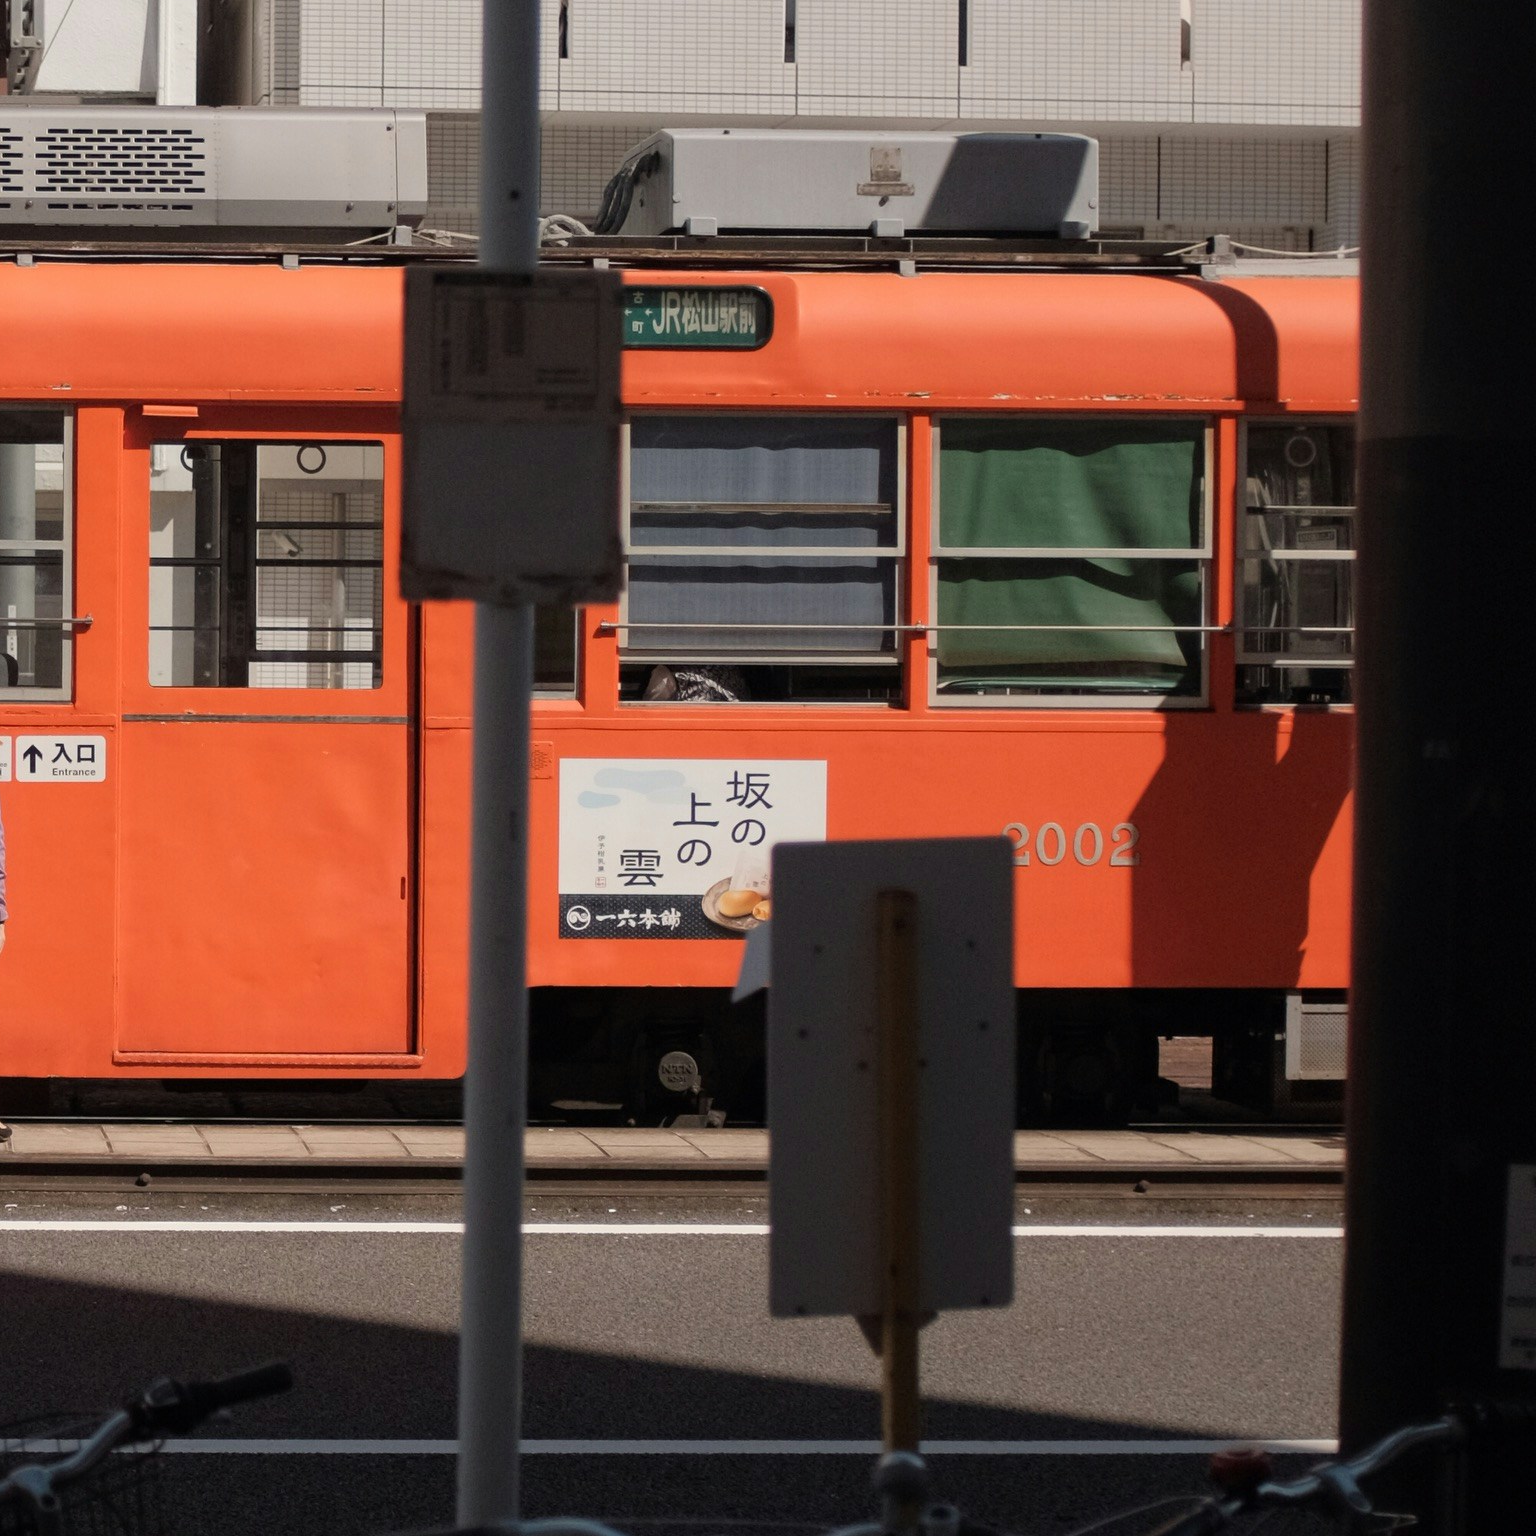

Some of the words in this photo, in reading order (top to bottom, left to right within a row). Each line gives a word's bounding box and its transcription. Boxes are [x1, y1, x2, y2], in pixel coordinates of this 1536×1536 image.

[652, 291, 757, 335] JR松山駅前
[51, 743, 96, 764] 入口
[52, 767, 96, 776] Entrance
[672, 792, 720, 866] 上の
[726, 770, 773, 846] 坂の
[1002, 822, 1140, 866] 2002
[617, 849, 664, 887] 雲
